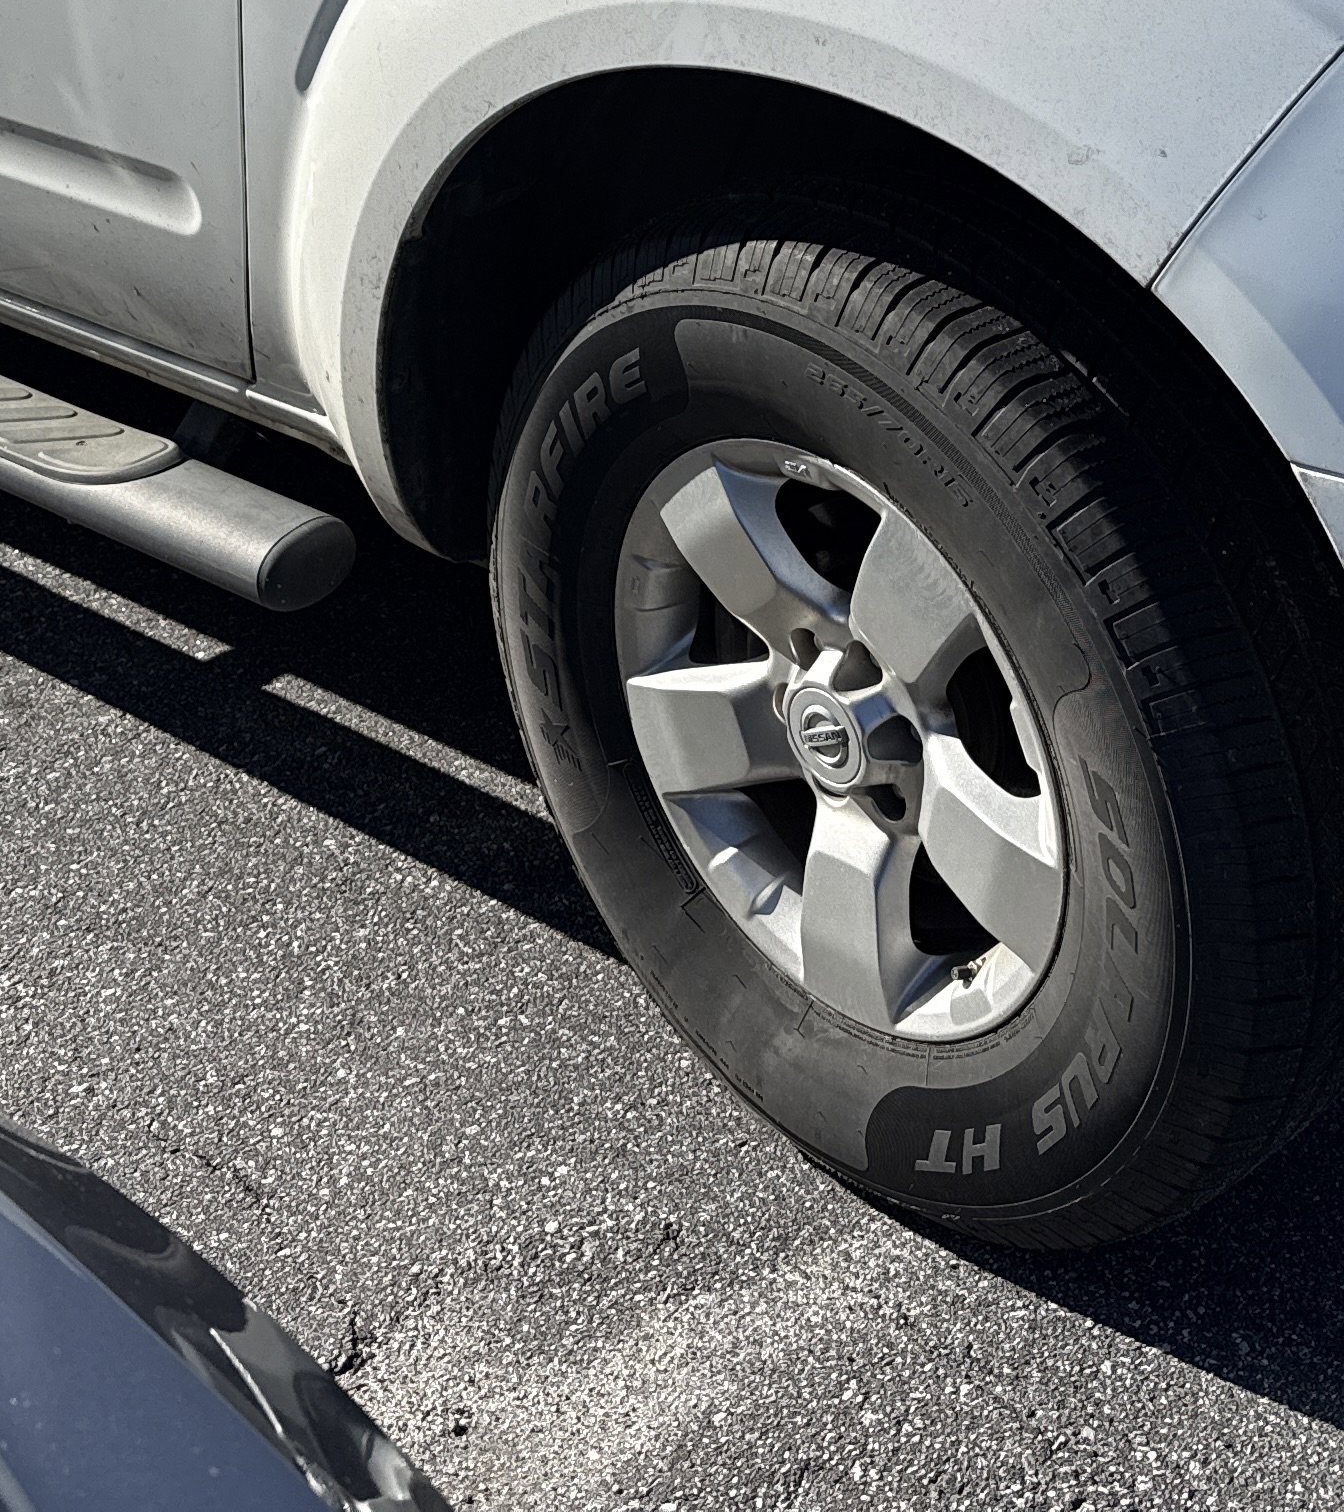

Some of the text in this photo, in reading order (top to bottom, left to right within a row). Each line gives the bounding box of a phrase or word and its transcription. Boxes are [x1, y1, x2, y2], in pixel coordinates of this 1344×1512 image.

[518, 346, 648, 713] STARFIRE
[804, 729, 842, 743] NISSAN
[1031, 754, 1140, 1156] SOLARUS
[914, 1122, 1002, 1176] HT
